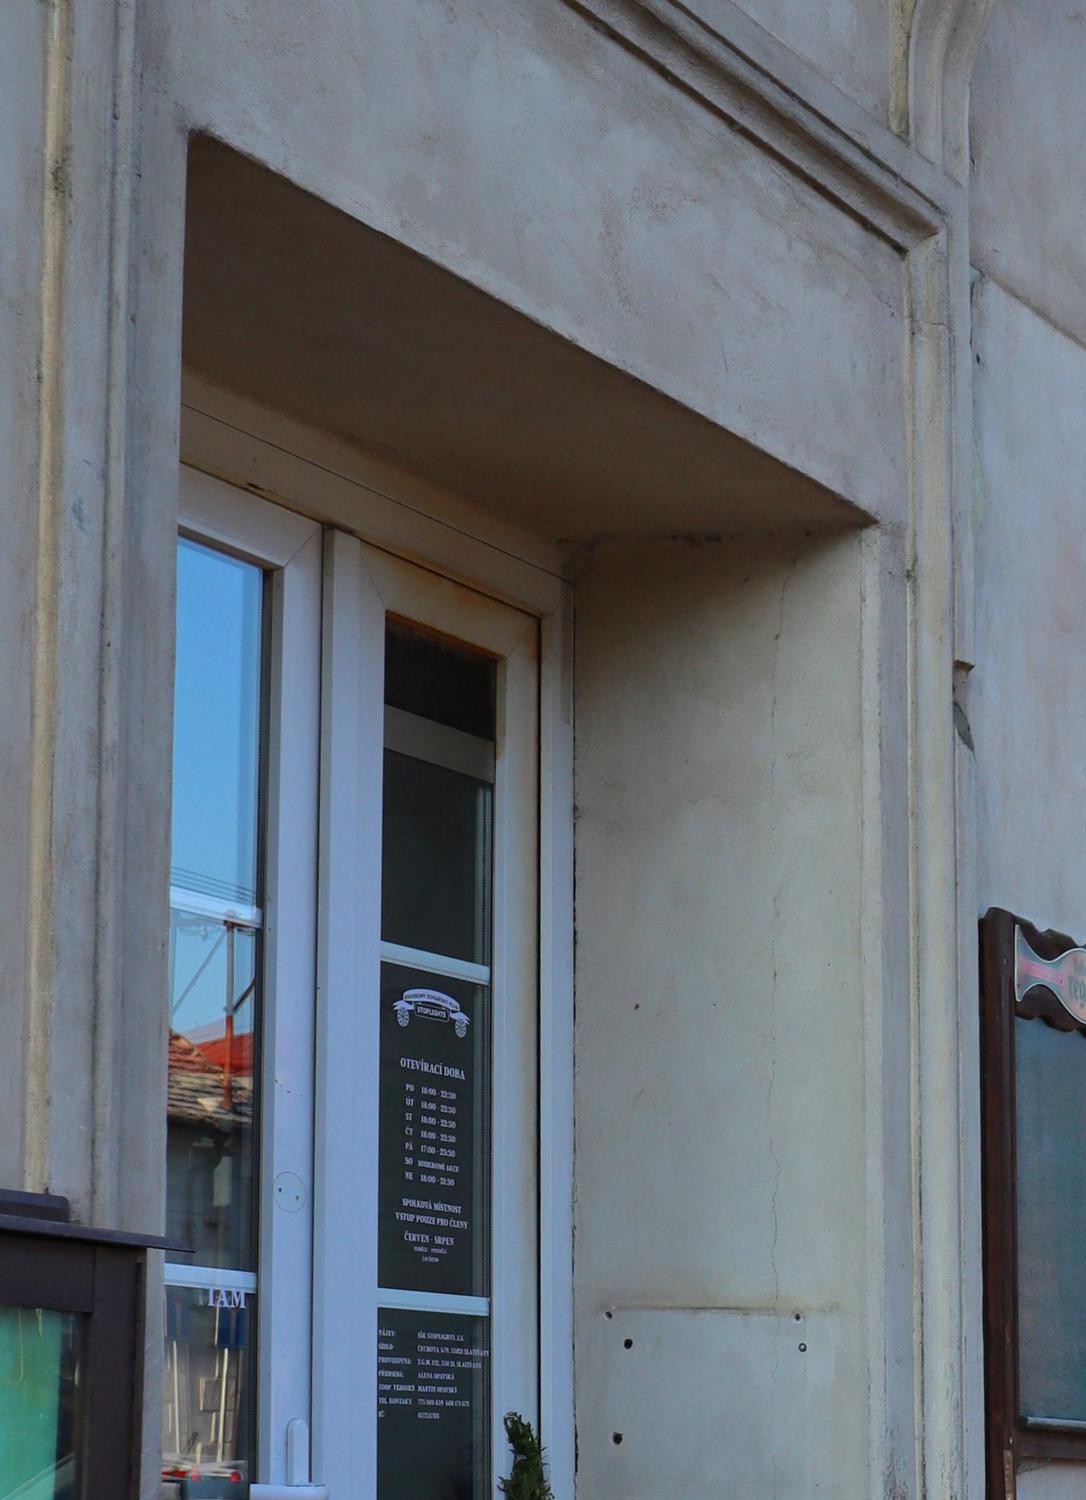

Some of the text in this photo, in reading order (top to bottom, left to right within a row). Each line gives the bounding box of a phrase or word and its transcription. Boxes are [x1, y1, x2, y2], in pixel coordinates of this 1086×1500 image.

[417, 1006, 447, 1019] STOPLIGHTS
[400, 1057, 466, 1081] OTEVÍRACÍ DOBA
[405, 1083, 415, 1092] PO
[405, 1156, 413, 1165] SO
